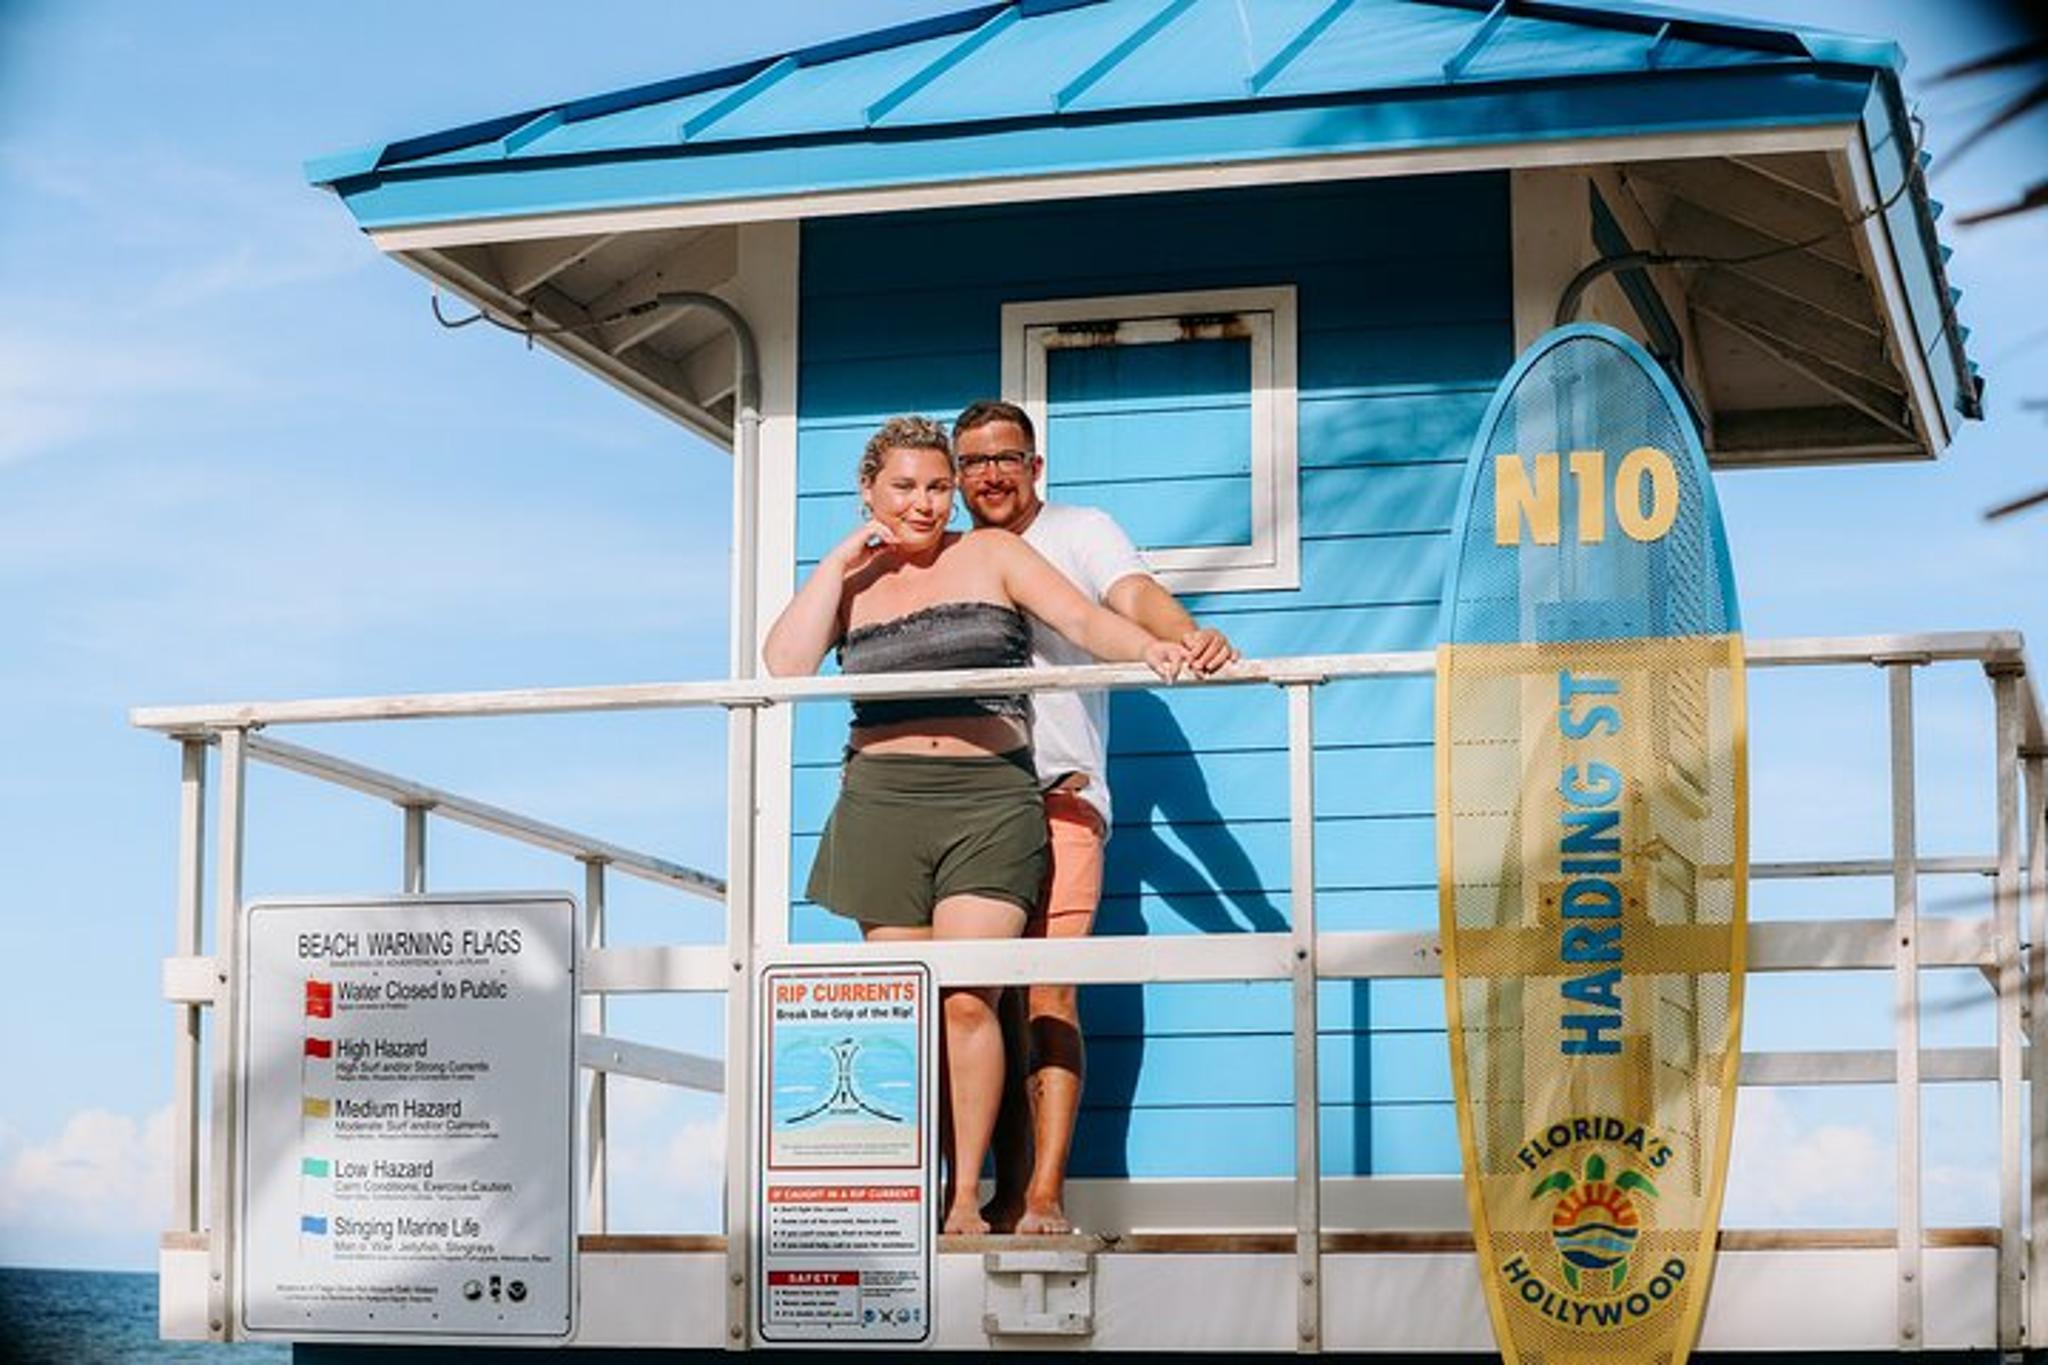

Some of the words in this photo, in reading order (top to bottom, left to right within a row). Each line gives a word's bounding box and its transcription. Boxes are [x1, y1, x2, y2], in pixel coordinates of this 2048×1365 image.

[1494, 446, 1681, 546] N10
[1558, 668, 1623, 741] ST
[1559, 761, 1624, 1056] HARDING
[298, 933, 359, 958] BEACH
[367, 931, 453, 956] WARNING
[463, 929, 522, 955] FLAGS
[337, 981, 382, 1000] Water
[386, 980, 438, 1000] Closed
[441, 981, 457, 999] to
[460, 980, 507, 999] Public
[776, 984, 808, 1003] RIP
[813, 983, 914, 1002] CURRENTS
[776, 1009, 808, 1020] Break
[810, 1008, 828, 1019] the
[831, 1008, 854, 1021] Grip
[856, 1008, 868, 1019] of
[870, 1008, 888, 1018] the
[892, 1006, 914, 1020] Rip!
[337, 1039, 370, 1061] High
[374, 1038, 428, 1058] Hazard
[360, 1060, 380, 1072] Surf
[415, 1060, 445, 1074] Strong
[449, 1060, 490, 1072] Currents
[335, 1099, 399, 1118] Medium
[403, 1099, 462, 1118] Hazard
[386, 1120, 407, 1131] Surf
[446, 1119, 490, 1130] Currents
[1516, 1116, 1673, 1171] FLORIDA'S
[335, 1160, 368, 1178] Low
[373, 1160, 433, 1178] Hazard
[423, 1180, 467, 1192] Exercise
[471, 1180, 513, 1192] Caution
[784, 1188, 825, 1199] CAUGHT
[850, 1188, 866, 1198] RIP
[868, 1188, 915, 1198] CURRENT
[334, 1217, 393, 1240] Stinging
[398, 1217, 449, 1238] Marine
[452, 1218, 480, 1238] Life
[788, 1273, 840, 1283] SAFETY
[1502, 1258, 1686, 1326] HOLLYWOOD
